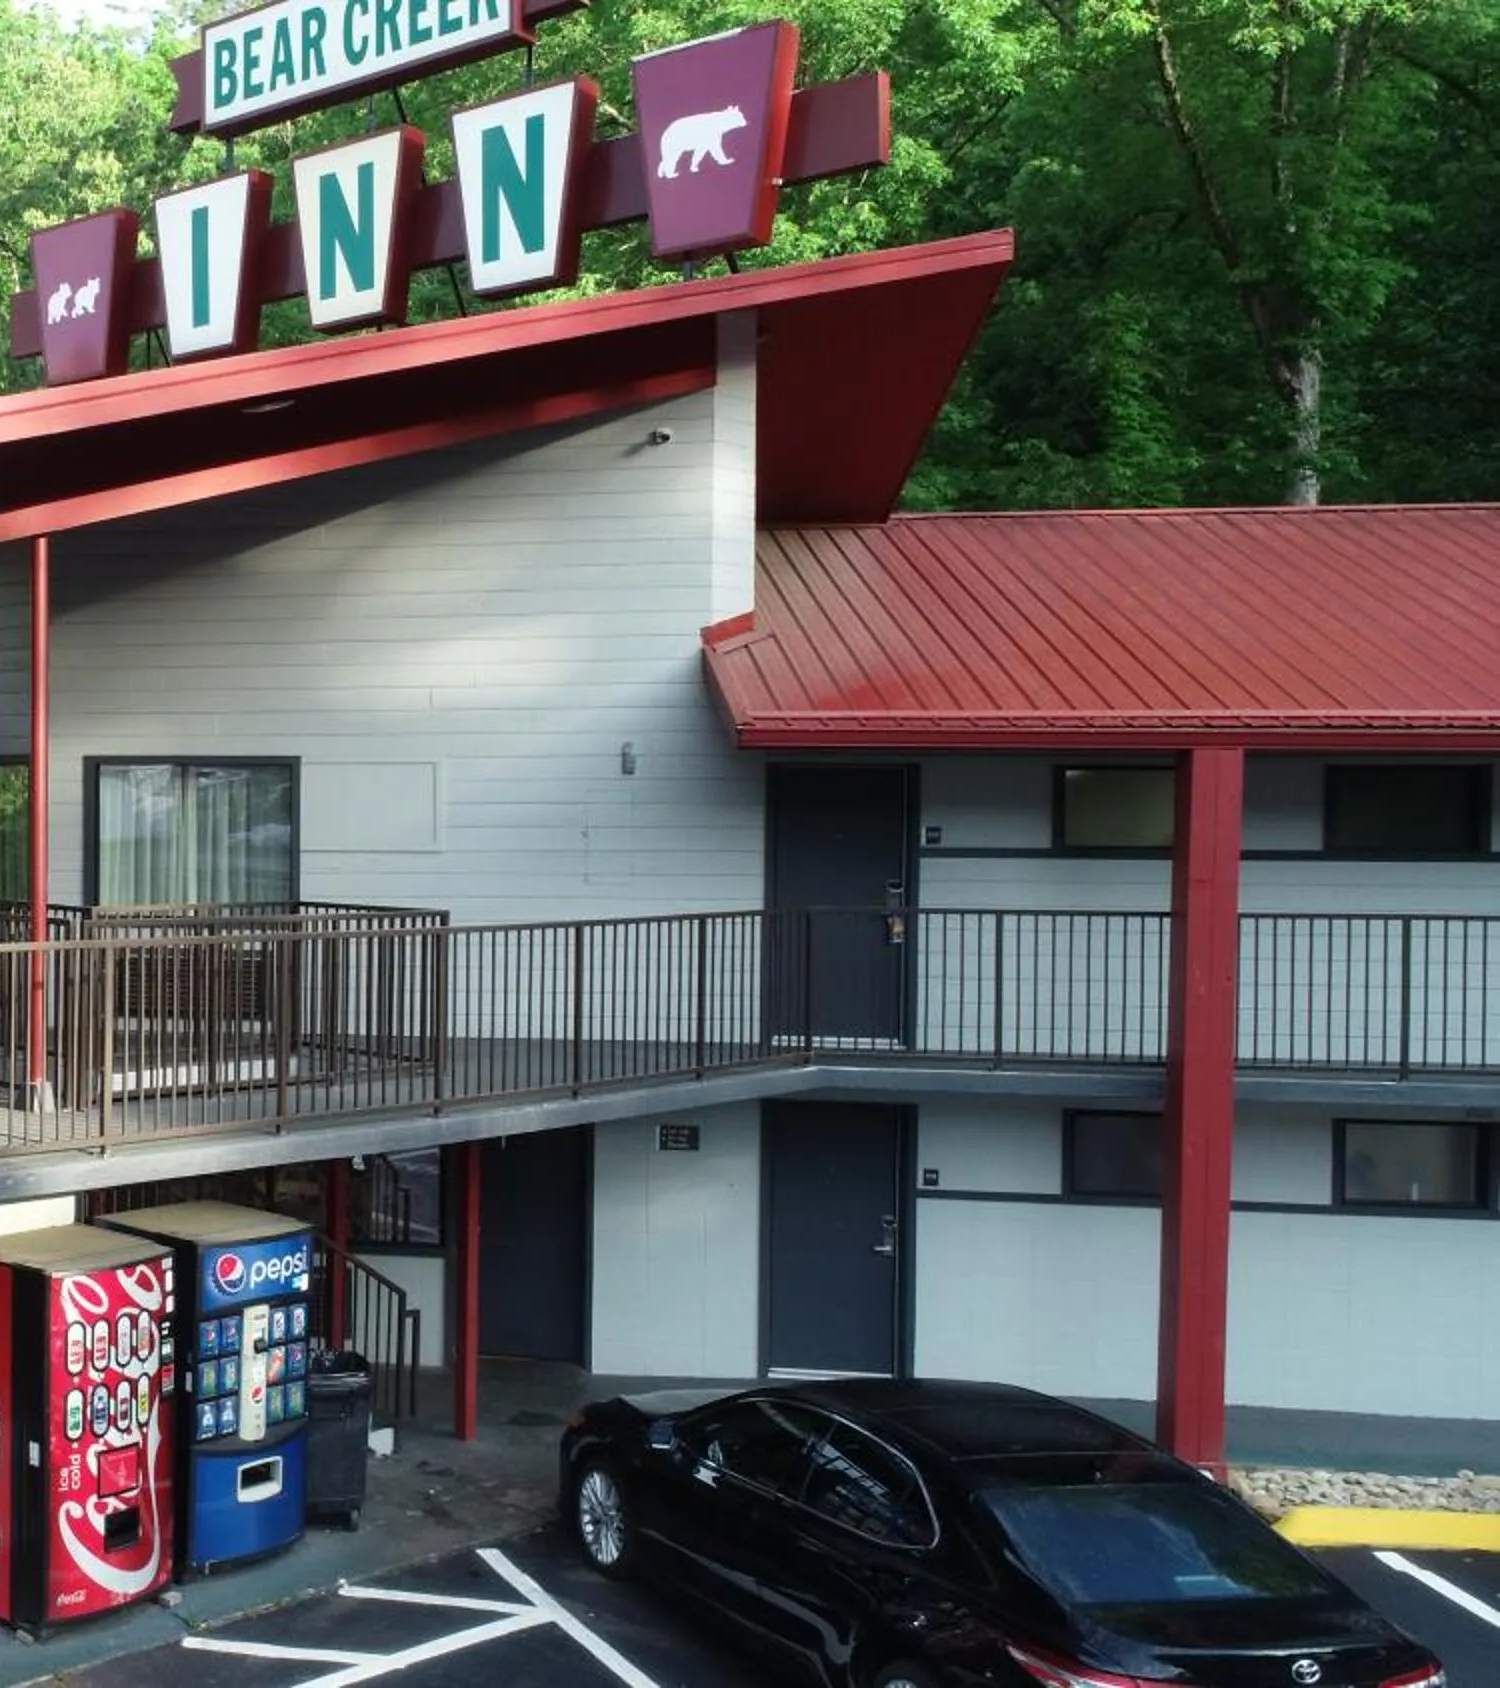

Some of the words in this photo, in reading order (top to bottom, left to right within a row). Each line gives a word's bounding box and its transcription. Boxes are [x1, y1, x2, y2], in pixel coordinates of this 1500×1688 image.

[213, 7, 327, 110] BEAR
[190, 112, 546, 328] INN
[250, 1244, 308, 1289] pepsi
[68, 1453, 81, 1490] cold
